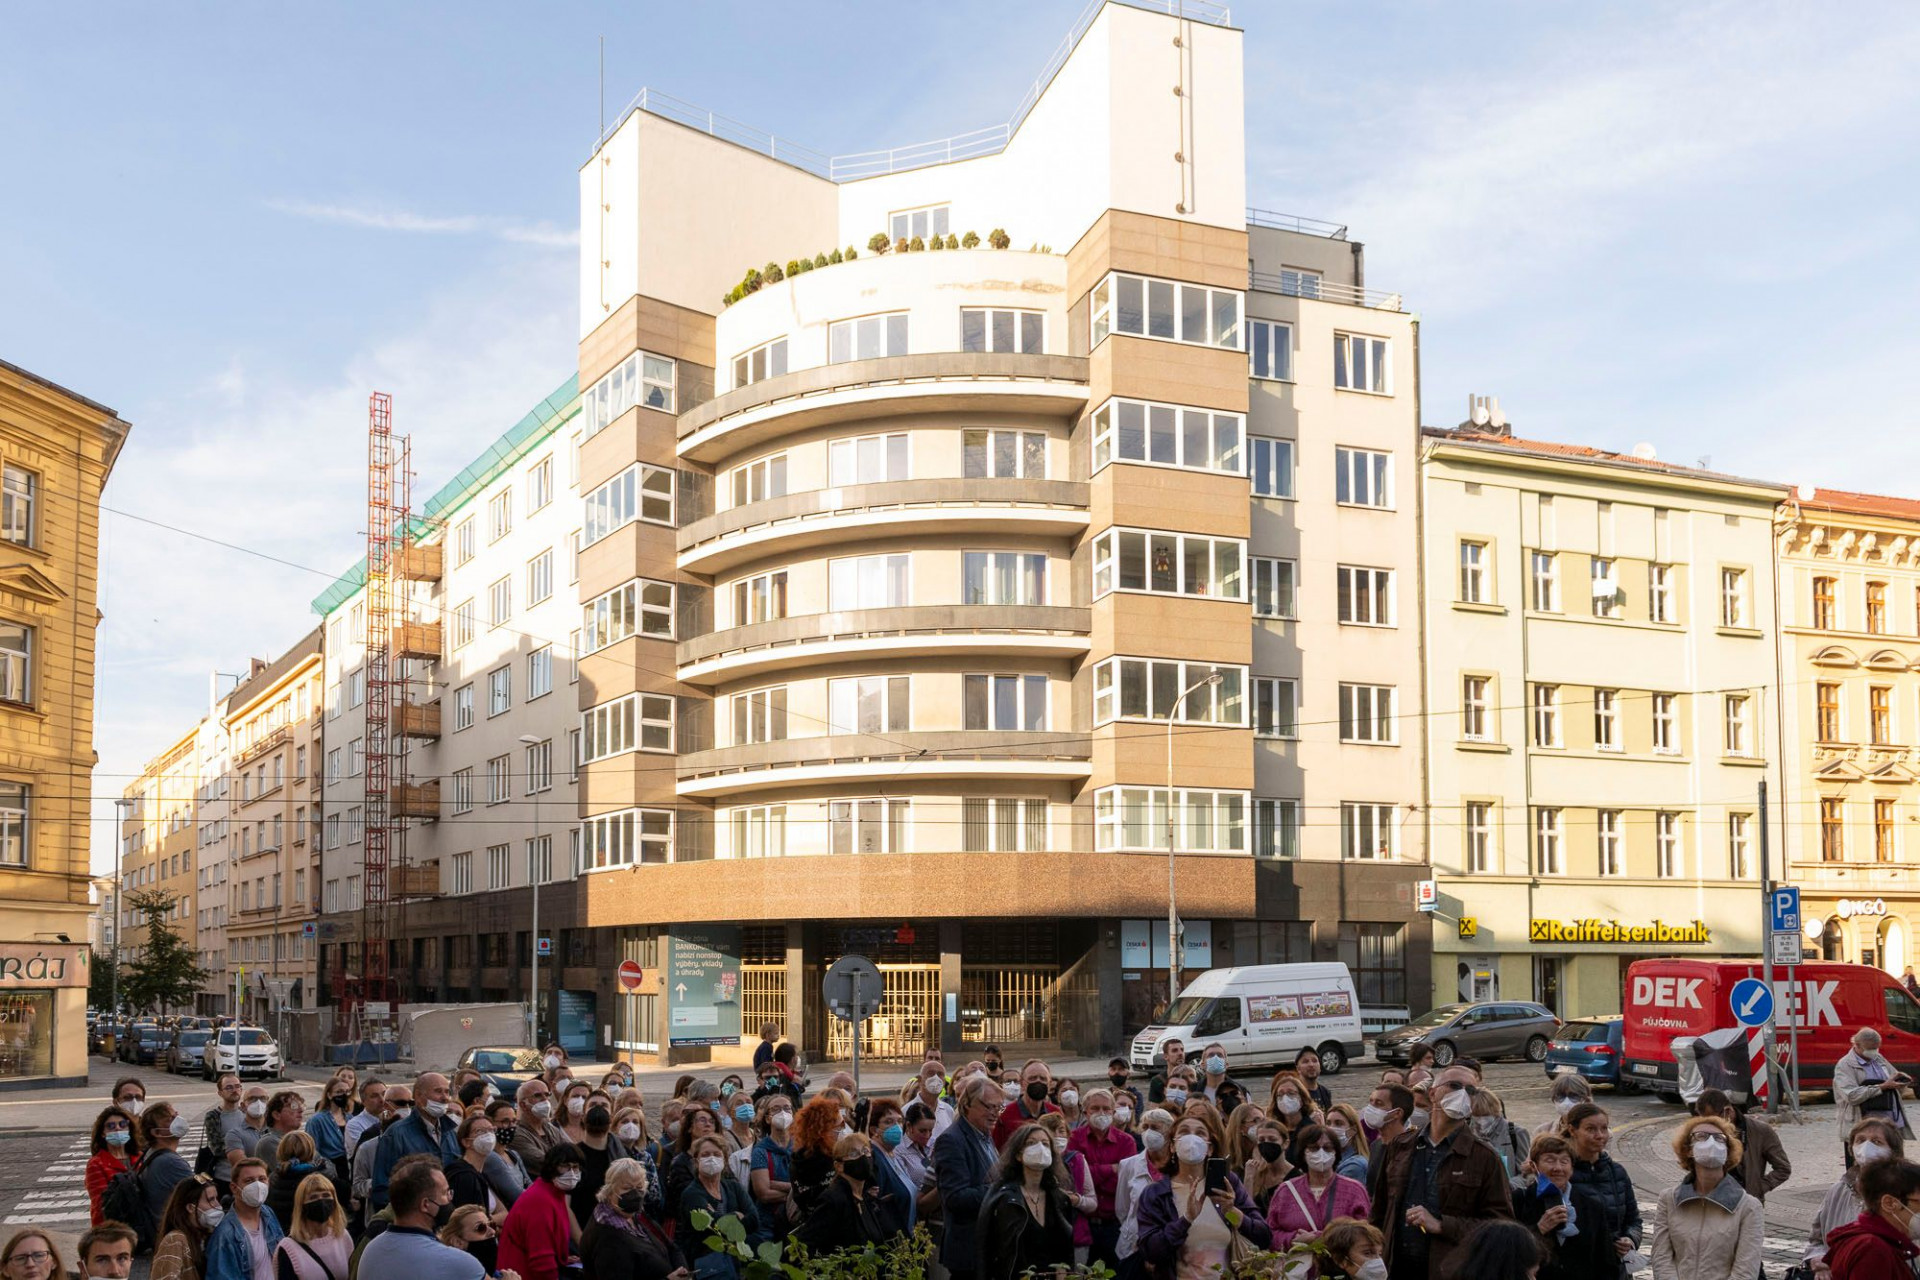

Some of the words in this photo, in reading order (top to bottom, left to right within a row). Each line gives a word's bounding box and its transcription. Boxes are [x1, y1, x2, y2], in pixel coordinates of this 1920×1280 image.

[1776, 893, 1793, 918] P
[1549, 919, 1711, 942] Raiffeisenbank
[675, 951, 695, 959] nabízí
[696, 952, 722, 960] nonstop
[701, 960, 723, 968] vklady
[680, 968, 704, 977] úhrady
[1633, 977, 1704, 1009] DEK
[1735, 980, 1842, 1027] EK
[1642, 1016, 1689, 1028] PŮJČOVNA
